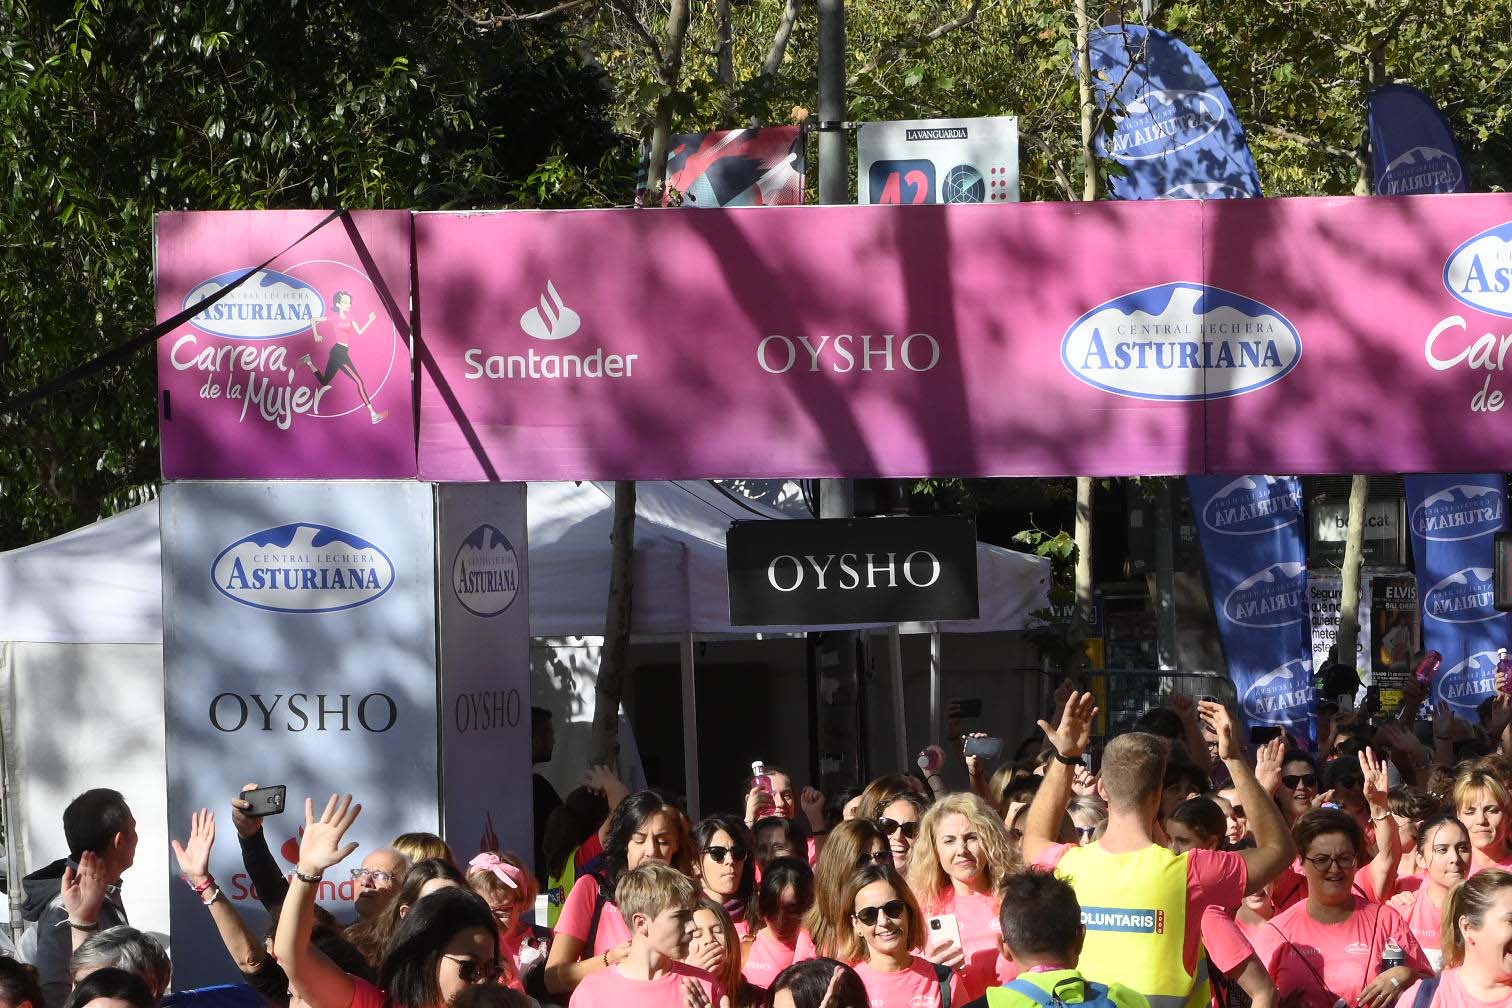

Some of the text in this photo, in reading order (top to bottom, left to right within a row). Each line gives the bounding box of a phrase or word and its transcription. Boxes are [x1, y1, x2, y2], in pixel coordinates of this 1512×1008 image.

[1117, 323, 1274, 336] CENTRAL LECHERA
[170, 334, 288, 371] Carrera
[464, 348, 638, 379] Santander
[756, 332, 941, 375] OYSHO
[1080, 328, 1283, 370] ASTURIANA
[200, 368, 333, 430] de la Mujer
[1470, 374, 1505, 412] de
[226, 556, 381, 590] ASTURIANA
[253, 554, 375, 563] CENTRAL LECHERA
[457, 559, 515, 595] ASTURIANA
[767, 550, 941, 593] OYSHO
[1386, 586, 1416, 599] ELVIS
[209, 692, 398, 733] OYSHO
[455, 689, 521, 734] OYSHO
[1080, 911, 1154, 928] OLUNTARIS
